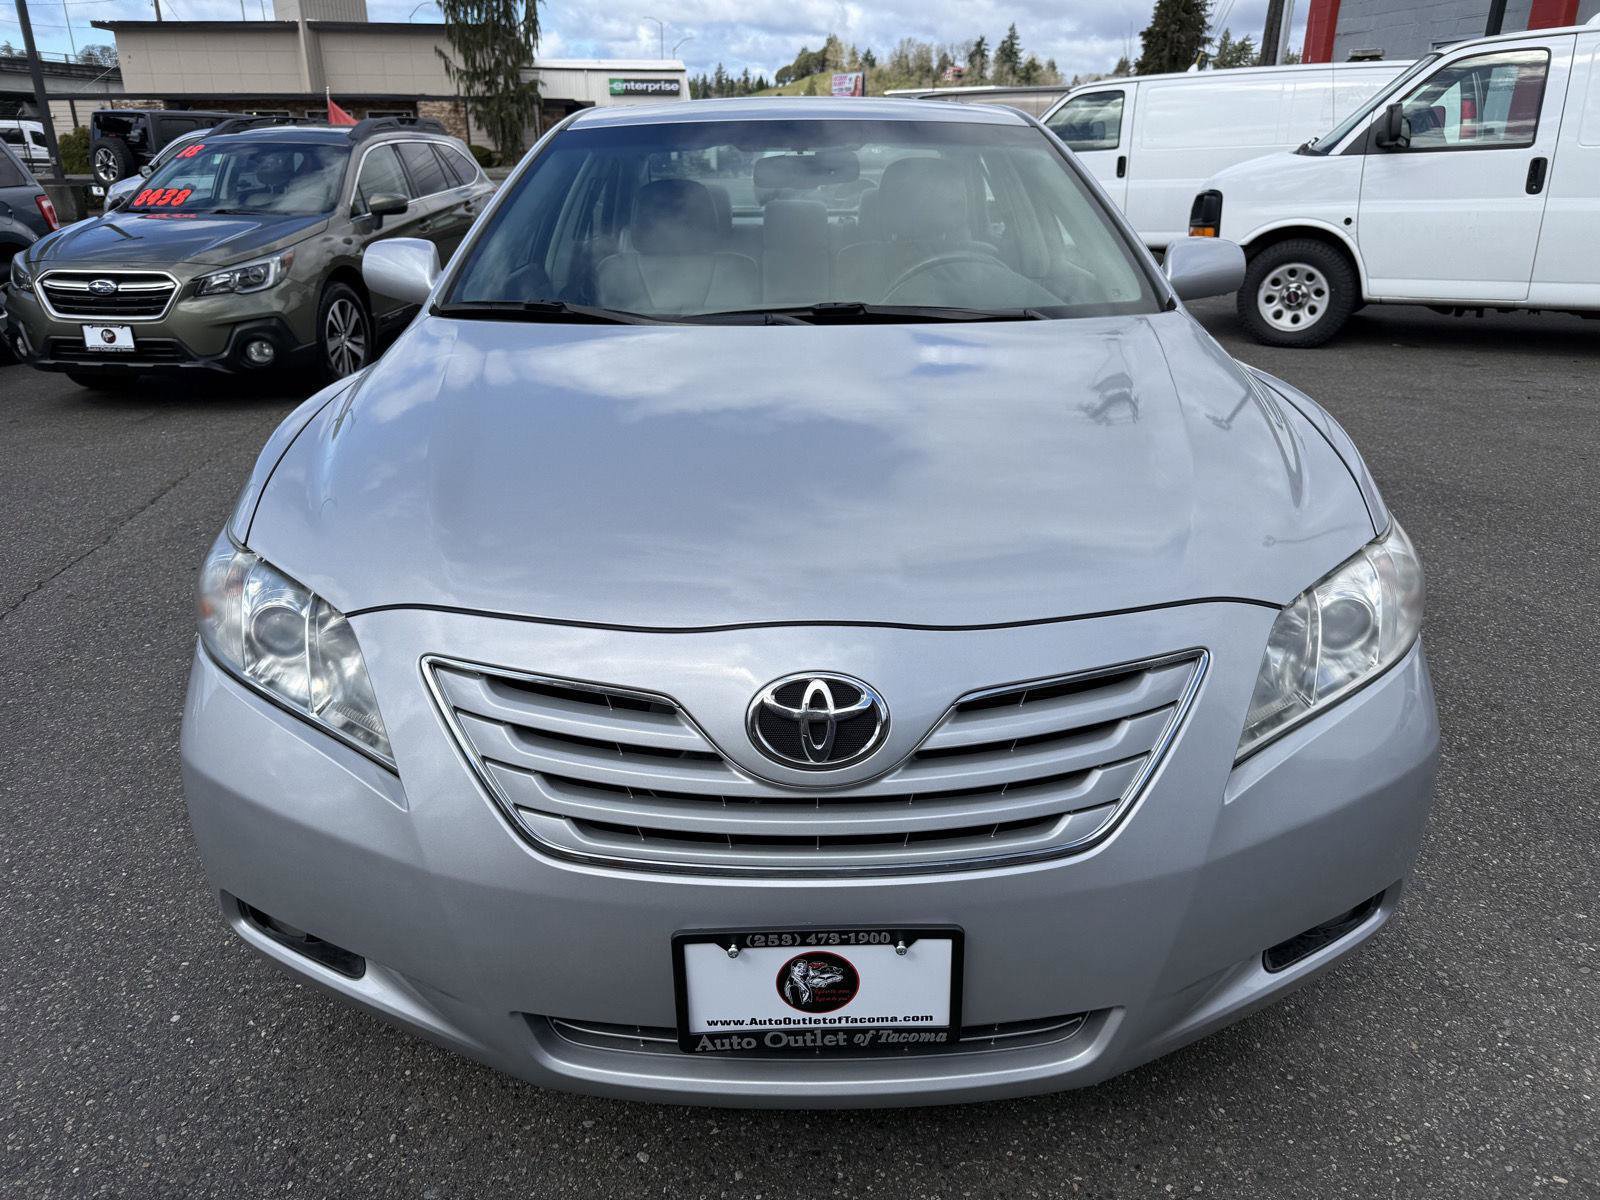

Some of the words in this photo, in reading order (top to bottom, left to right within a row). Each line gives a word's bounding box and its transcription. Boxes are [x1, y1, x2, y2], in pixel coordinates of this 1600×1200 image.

[613, 81, 679, 92] enterprise
[746, 934, 800, 947] (253)
[806, 932, 891, 945] 473-1900
[707, 1015, 934, 1027] www.AutoOutletofTacoma.com
[695, 1034, 757, 1052] Auto
[763, 1029, 847, 1048] Outlet
[853, 1030, 876, 1046] of
[877, 1030, 948, 1043] Tacoma
